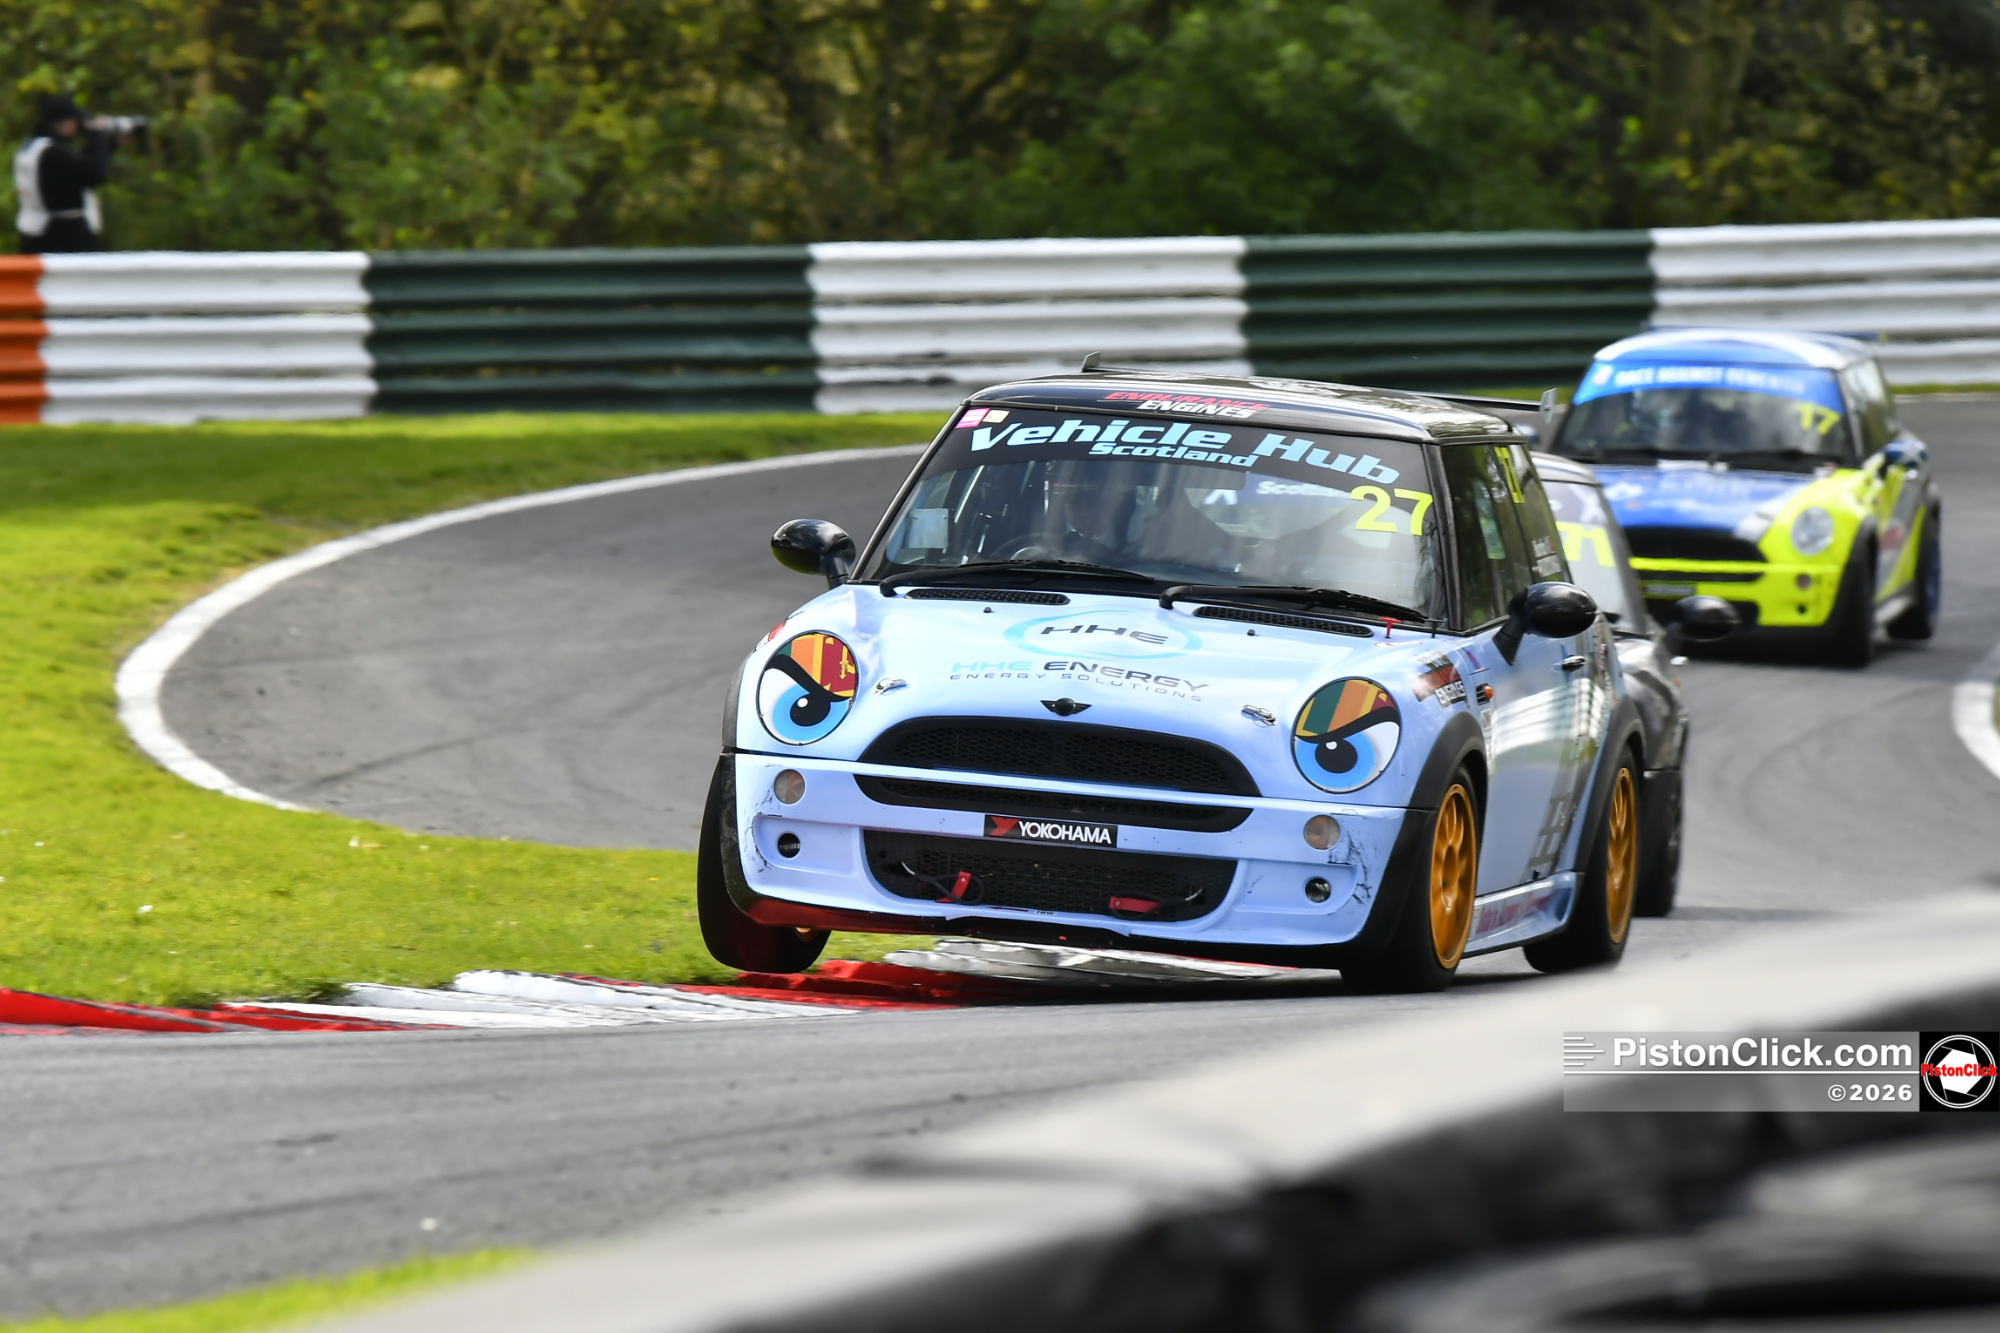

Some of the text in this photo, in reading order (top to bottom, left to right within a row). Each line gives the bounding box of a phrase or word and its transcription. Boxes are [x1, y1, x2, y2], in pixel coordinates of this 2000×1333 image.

[1105, 391, 1271, 411] ENDURANCE
[1136, 400, 1258, 419] ENGINES
[1797, 402, 1841, 435] 17
[971, 419, 1400, 484] Vehicle Hub
[1089, 442, 1259, 467] Scotland
[1350, 485, 1434, 536] 27
[1040, 624, 1169, 645] HHE
[950, 672, 1202, 702] ENERGY SOLUTIONS
[951, 661, 1209, 692] HHE ENERGY
[1018, 820, 1112, 845] YOKOHAMA
